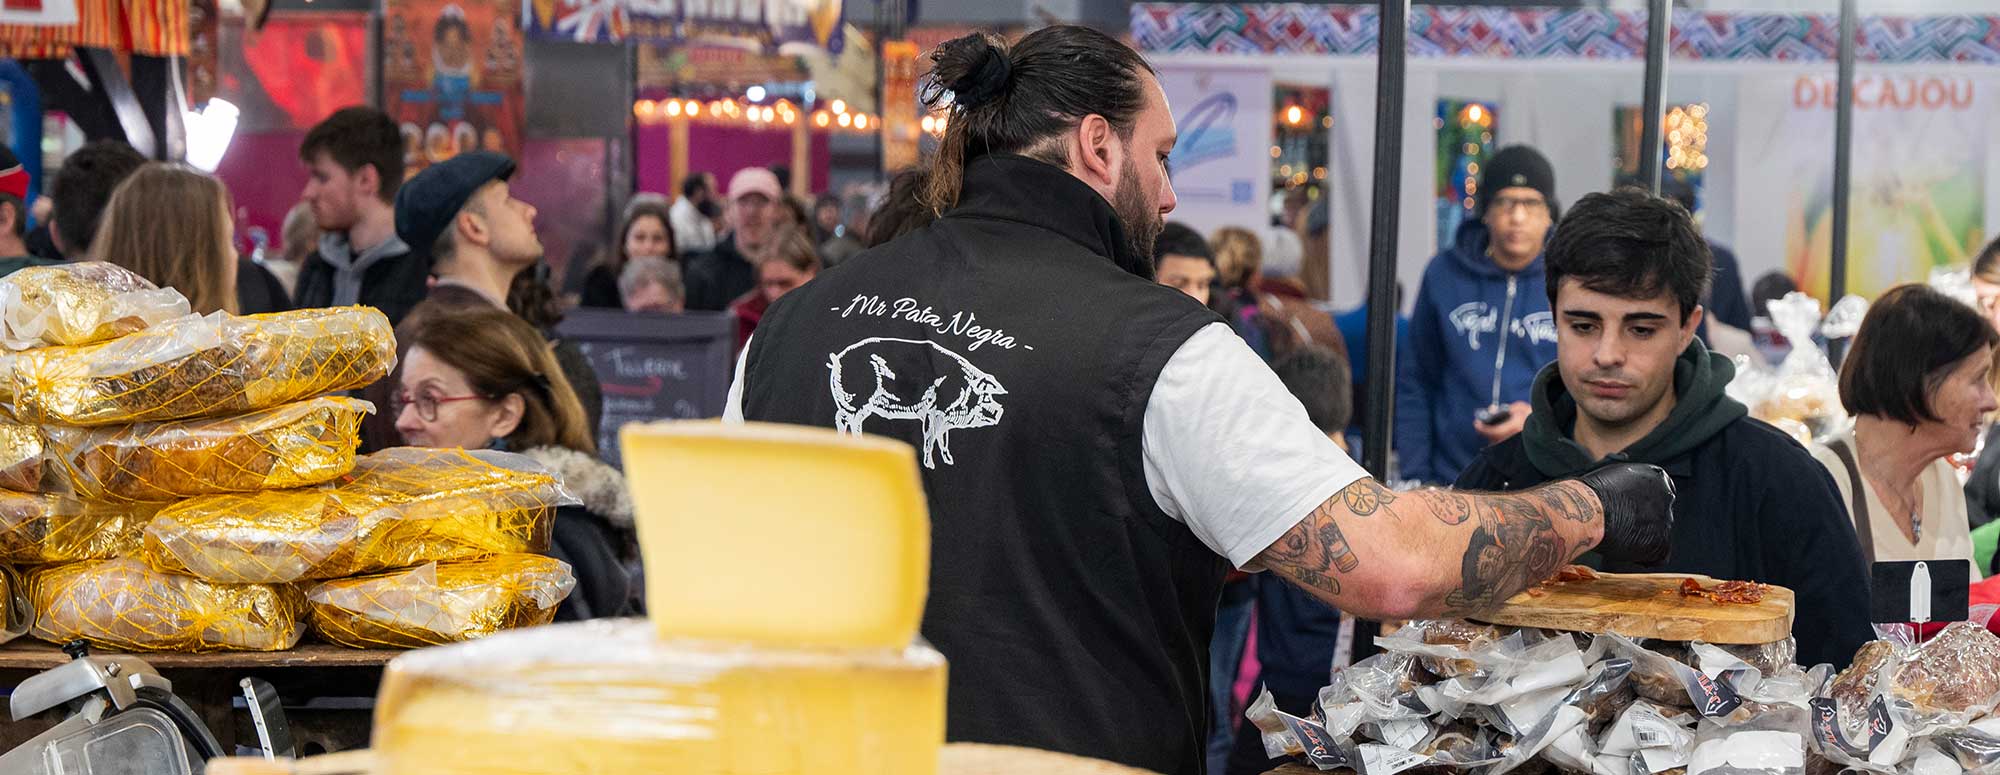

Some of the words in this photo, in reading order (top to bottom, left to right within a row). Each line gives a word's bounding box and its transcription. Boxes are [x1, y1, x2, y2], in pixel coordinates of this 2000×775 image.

[1852, 78, 1974, 111] CAJOU
[841, 293, 887, 318] Mr
[892, 297, 943, 328] Pata
[936, 311, 1017, 351] Negra
